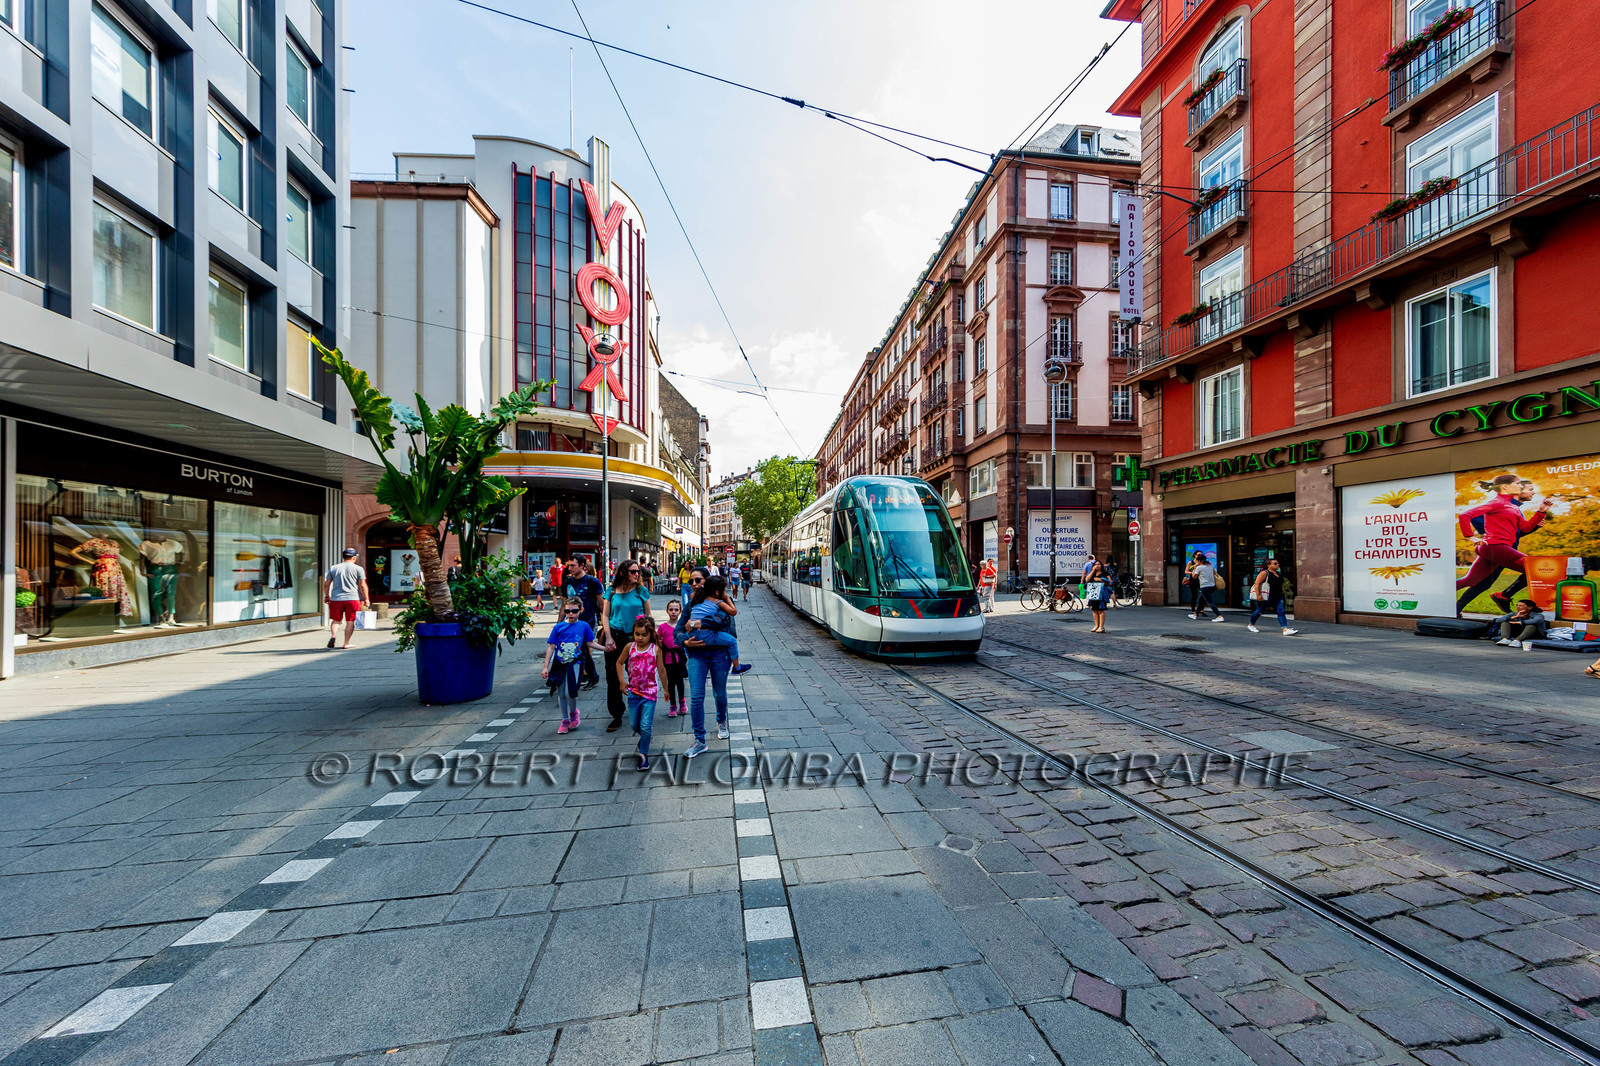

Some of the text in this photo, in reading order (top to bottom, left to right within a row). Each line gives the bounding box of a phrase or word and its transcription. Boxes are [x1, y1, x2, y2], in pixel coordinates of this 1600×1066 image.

[1127, 203, 1136, 305] MAISON ROUGE
[576, 178, 631, 402] VOX
[1123, 307, 1140, 315] HOTEL
[1159, 380, 1600, 488] PHARMACIE DU CYGN
[1546, 461, 1600, 474] WELEDA
[181, 463, 253, 489] BURTON
[234, 488, 253, 496] London
[1365, 512, 1428, 525] L'ARNICA
[1382, 525, 1409, 536] BIO,
[1366, 536, 1428, 548] L'OR DES
[1355, 548, 1441, 559] CHAMPIONS
